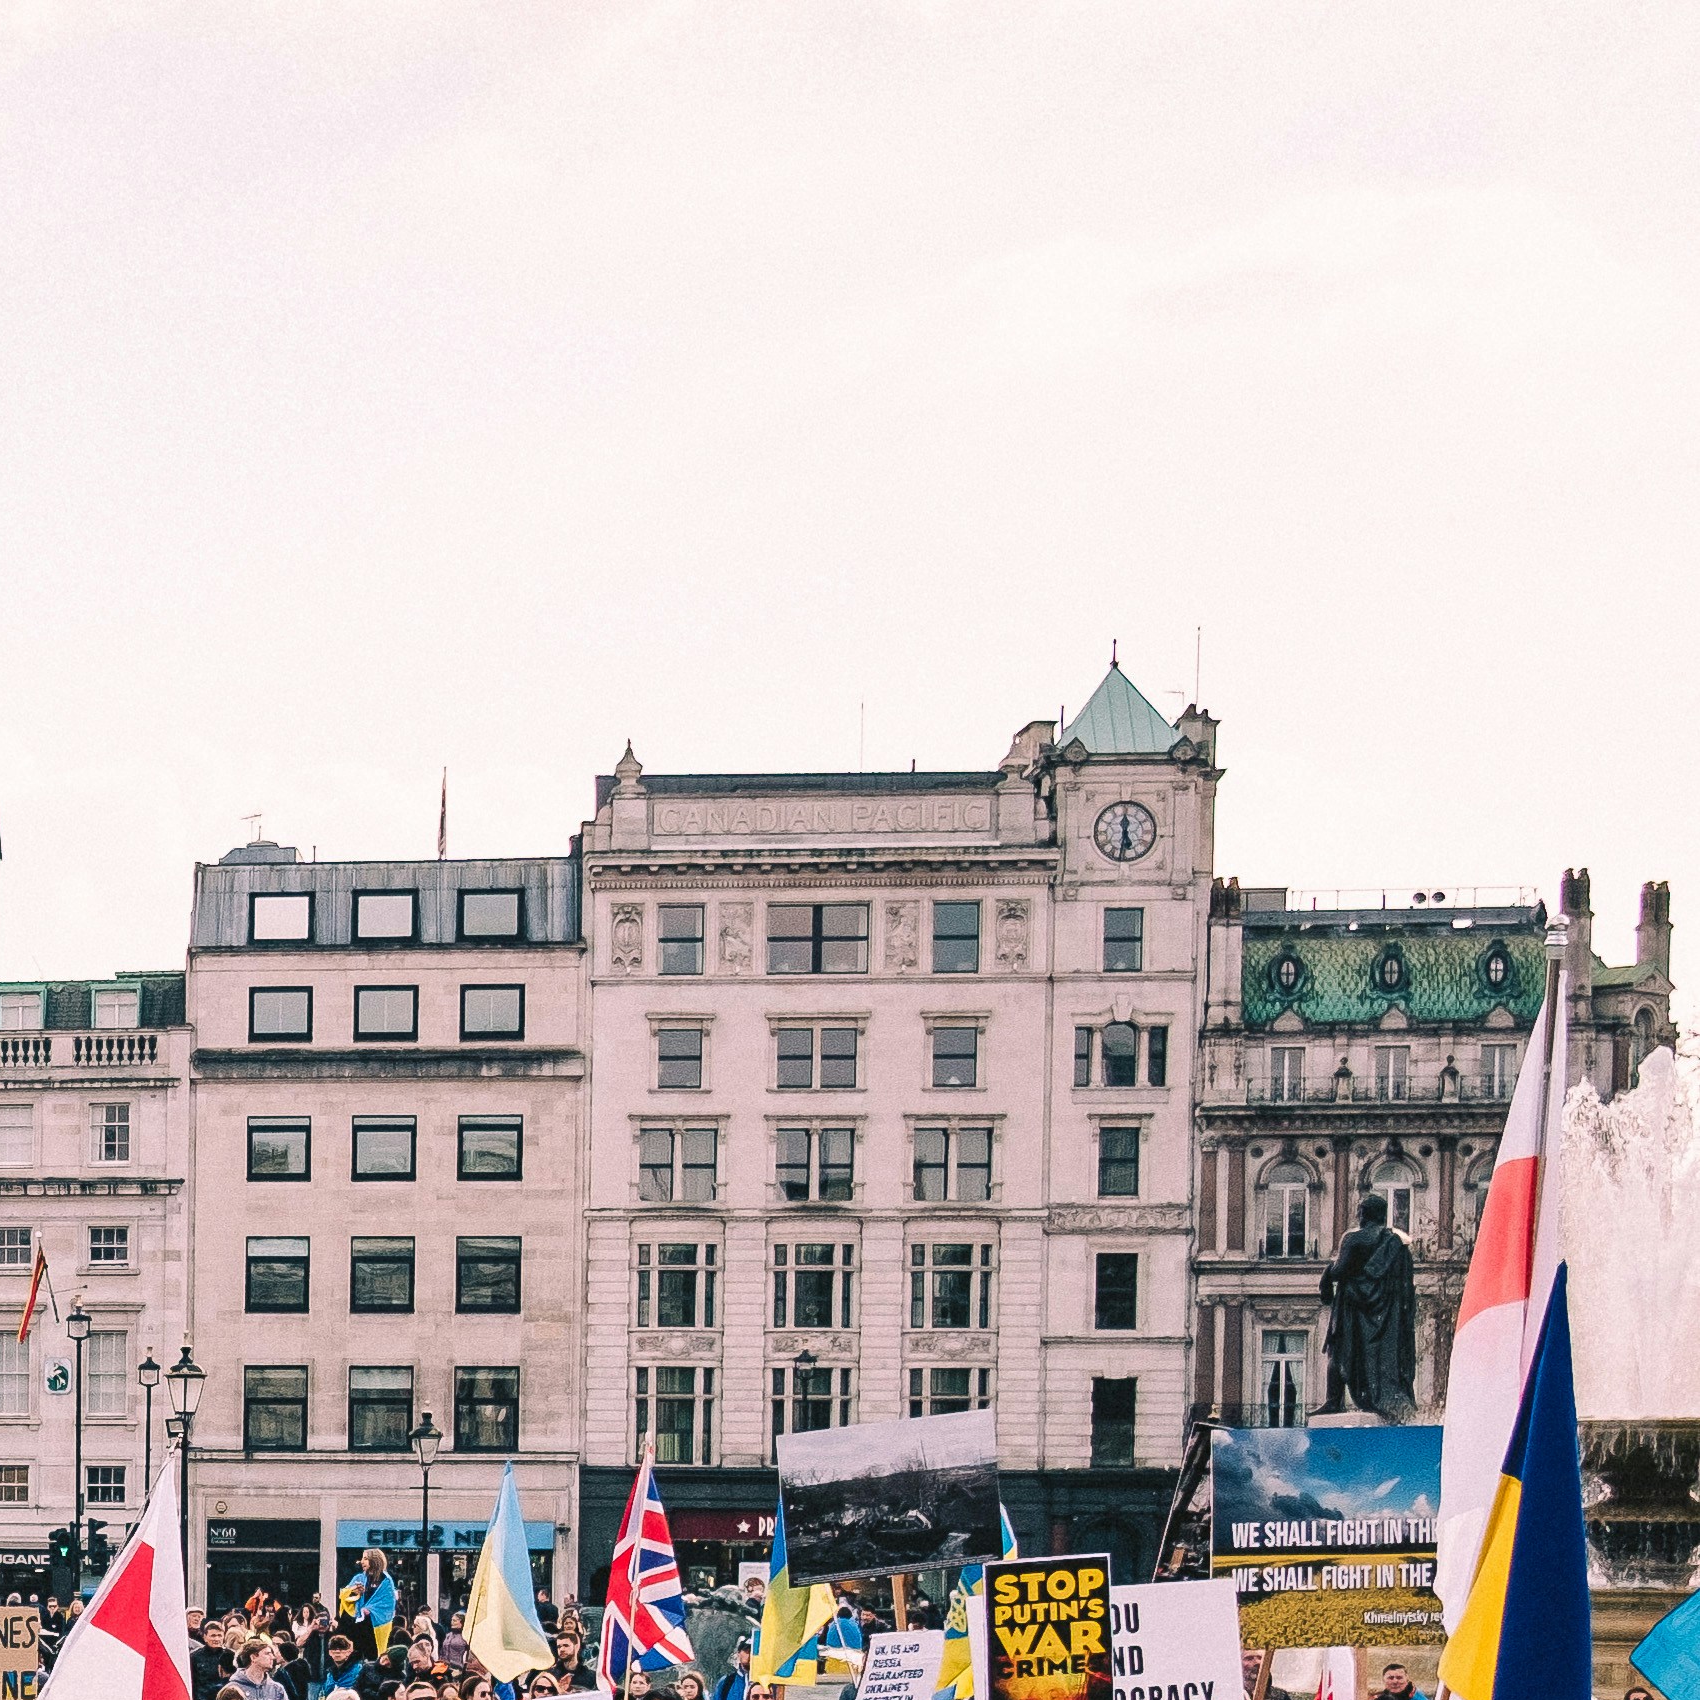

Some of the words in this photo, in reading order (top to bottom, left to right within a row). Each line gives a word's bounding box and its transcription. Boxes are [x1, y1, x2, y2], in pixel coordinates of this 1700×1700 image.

[1232, 1522, 1261, 1548] WE
[1264, 1519, 1323, 1548] SHALL
[1326, 1518, 1379, 1546] FIGHT
[1383, 1517, 1403, 1544] IN
[994, 1568, 1104, 1604] STOP
[1232, 1567, 1260, 1593] WE
[1263, 1565, 1318, 1592] SHALL
[1322, 1563, 1373, 1590] FIGHT
[1376, 1563, 1395, 1588] IN
[1398, 1561, 1433, 1587] THE
[994, 1598, 1105, 1626] PUTIN'S
[1113, 1602, 1140, 1636] OU
[994, 1620, 1106, 1662] WAR
[1113, 1645, 1144, 1677] ND
